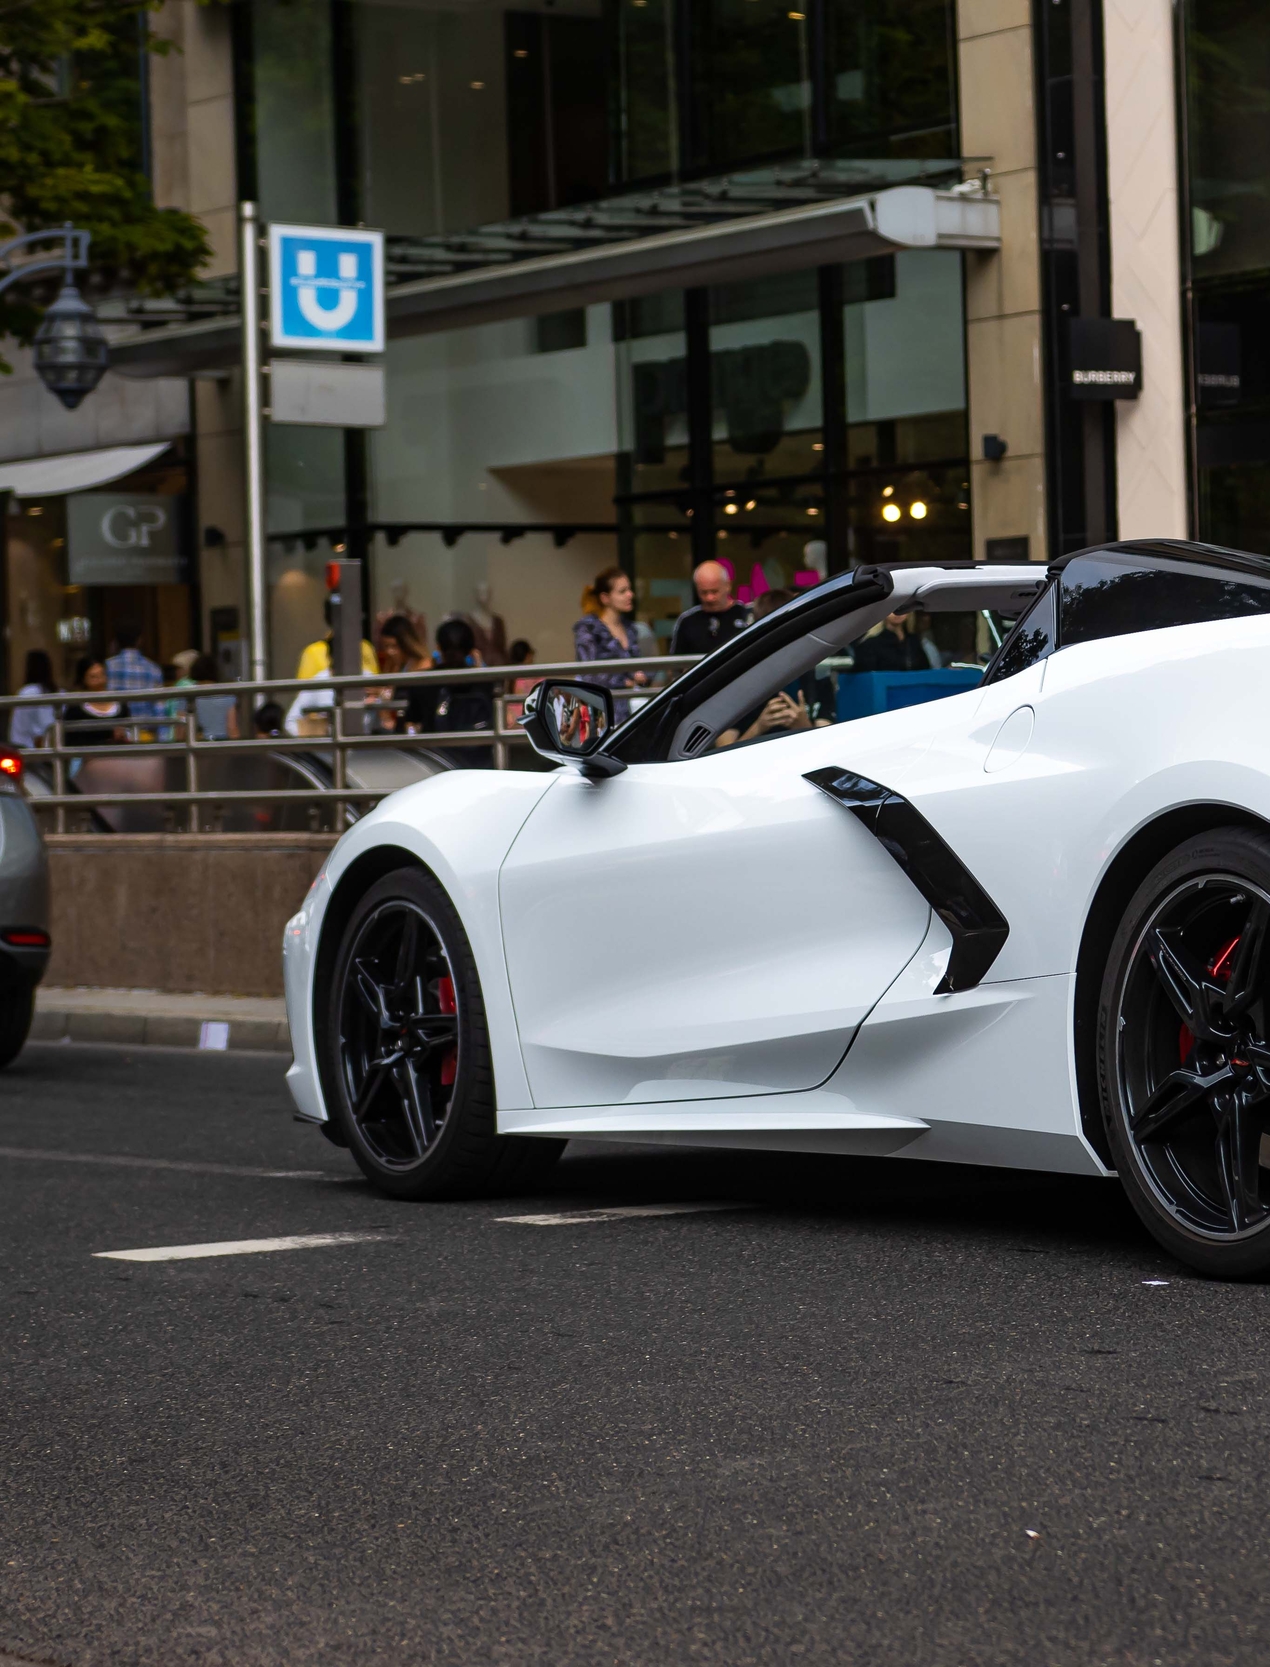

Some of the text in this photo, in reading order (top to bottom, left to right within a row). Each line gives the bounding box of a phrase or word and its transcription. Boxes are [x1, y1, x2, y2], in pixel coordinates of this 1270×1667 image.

[297, 249, 358, 332] U
[1072, 370, 1136, 384] BURBERRY
[101, 504, 166, 548] GP
